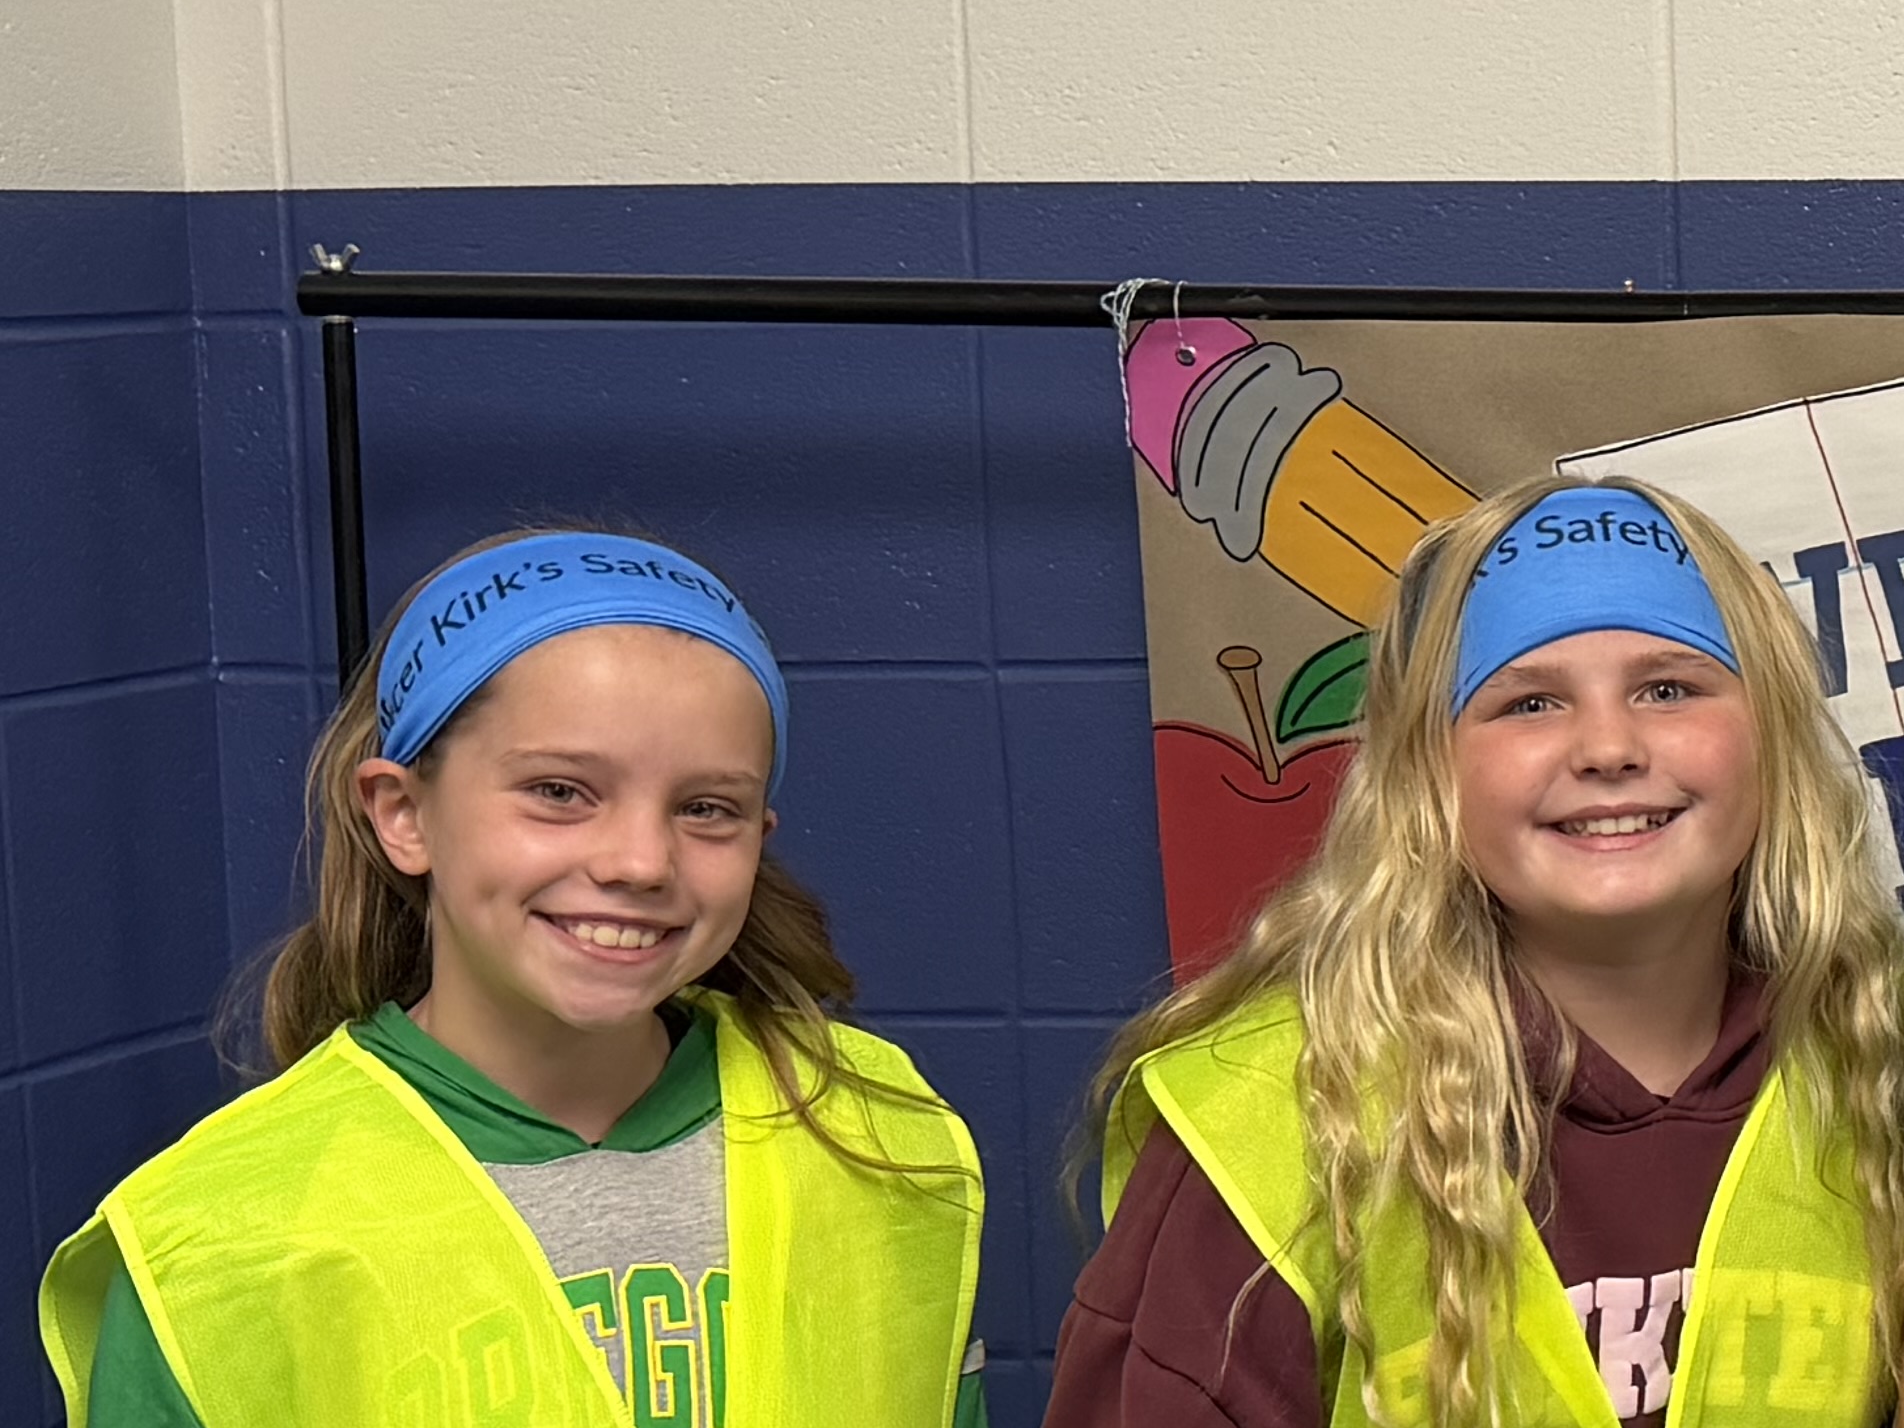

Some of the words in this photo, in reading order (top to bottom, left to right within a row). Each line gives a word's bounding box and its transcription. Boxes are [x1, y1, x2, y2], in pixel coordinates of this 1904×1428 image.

[1533, 510, 1689, 565] Safety
[430, 561, 564, 646] Kirk's
[580, 551, 736, 613] Safety
